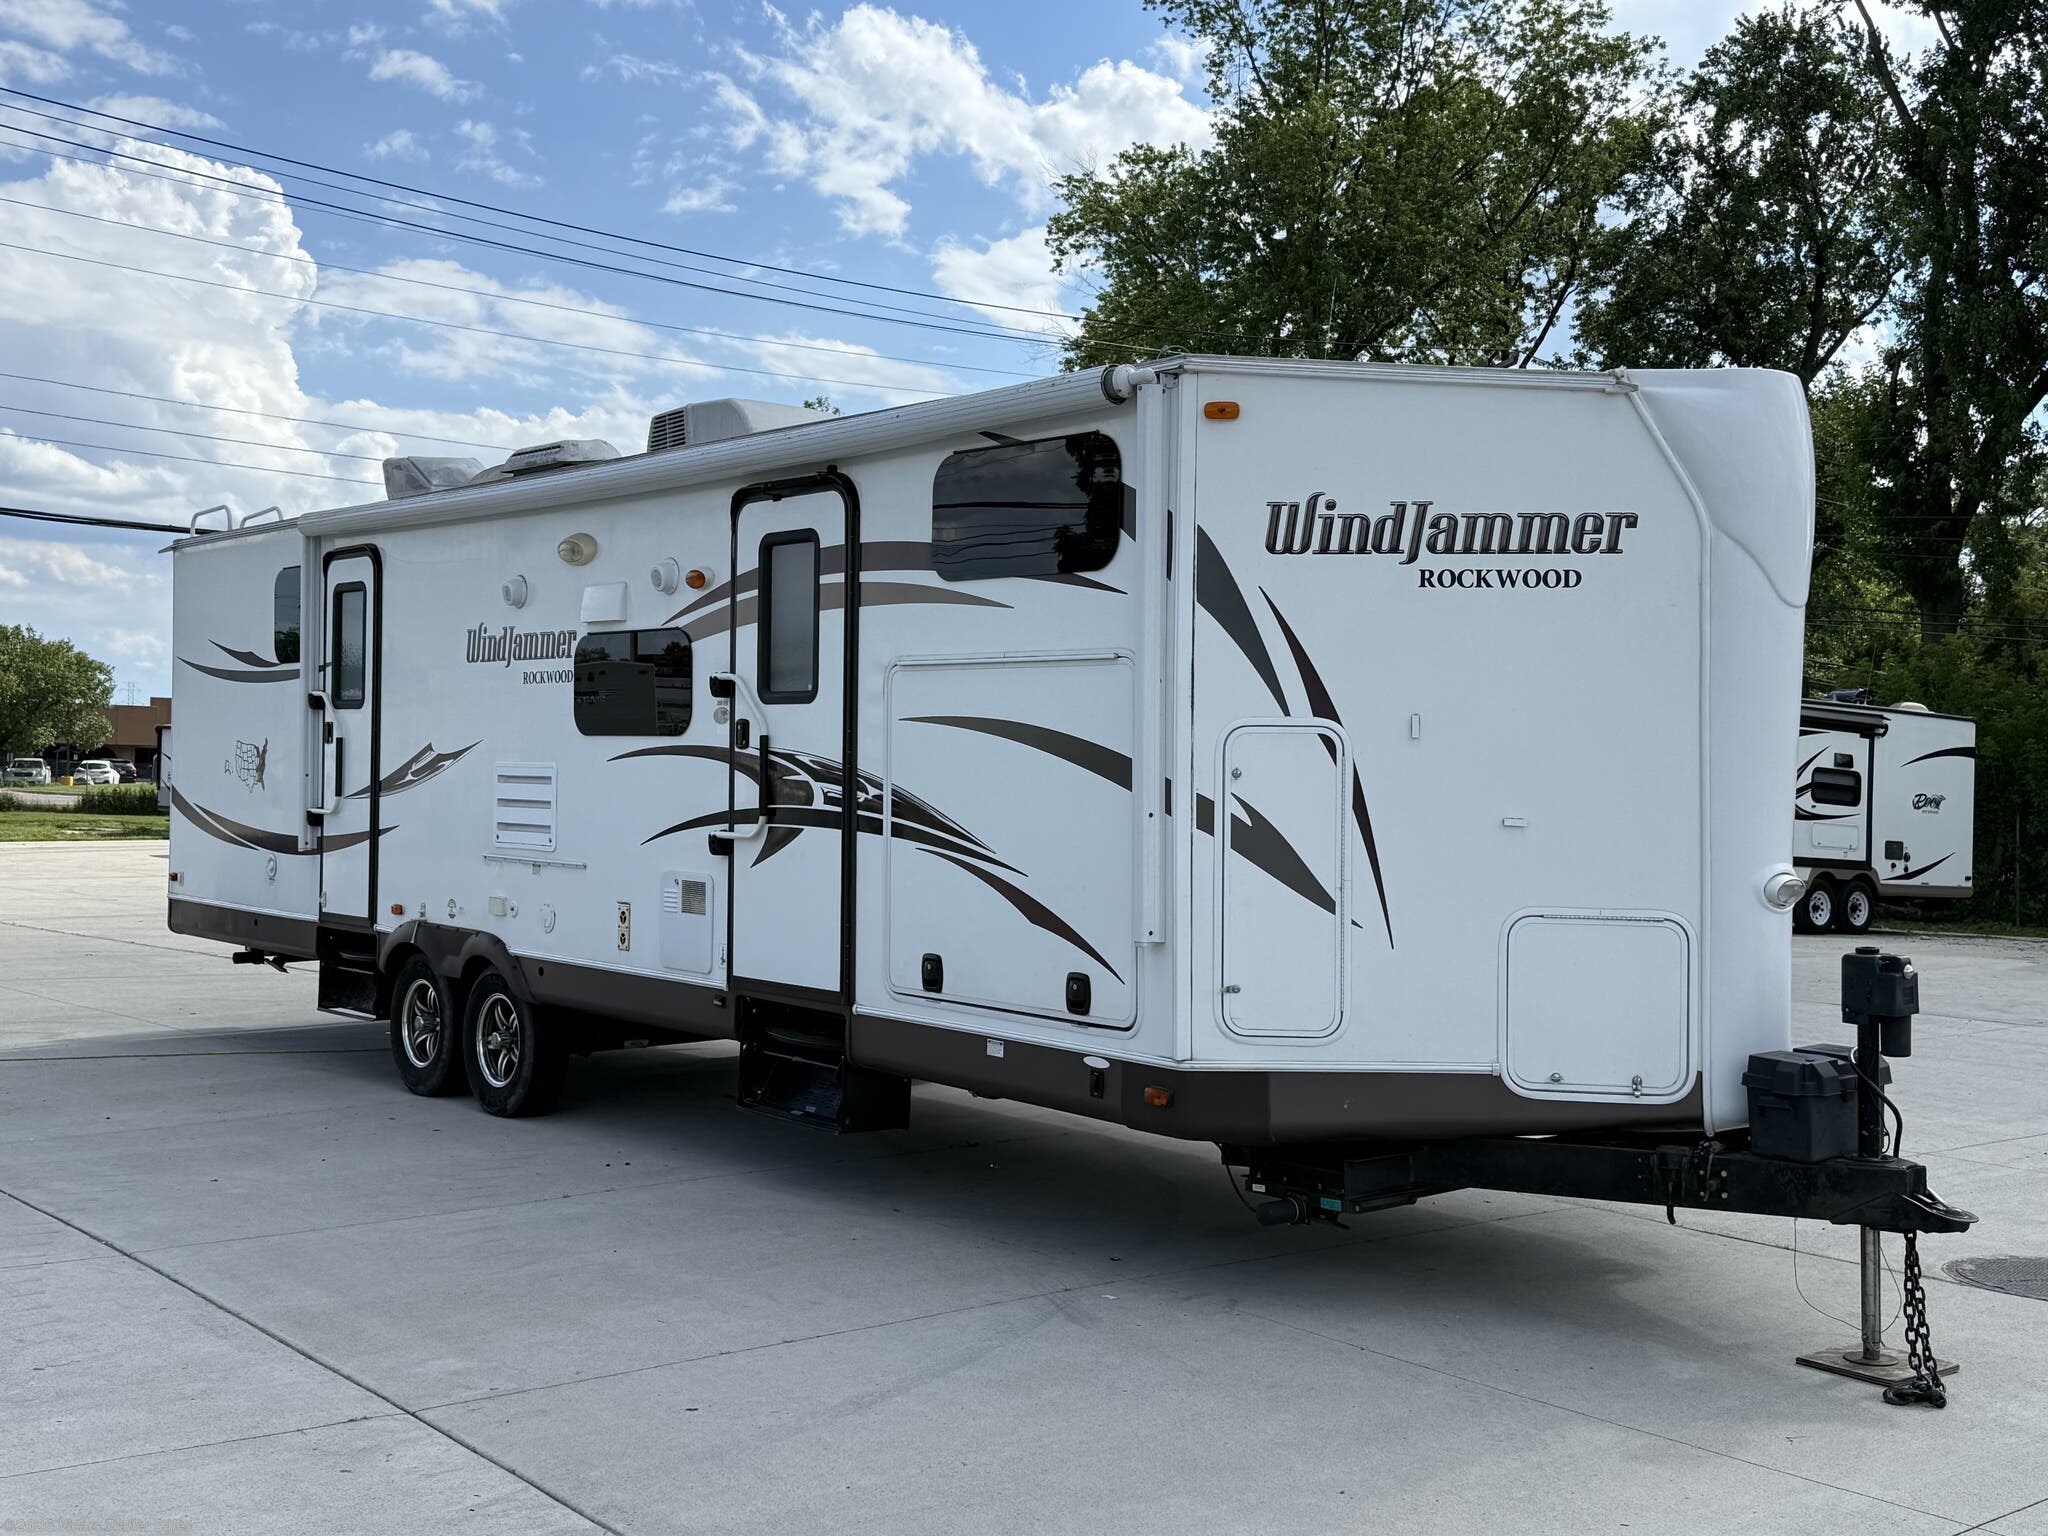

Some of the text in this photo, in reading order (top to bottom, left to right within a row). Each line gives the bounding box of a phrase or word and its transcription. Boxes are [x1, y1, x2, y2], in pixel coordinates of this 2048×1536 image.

[1264, 491, 1639, 565] WindJammer
[1418, 568, 1582, 589] ROCKWOOD
[466, 621, 577, 668] WindJammer
[522, 669, 574, 684] ROCKWOOD
